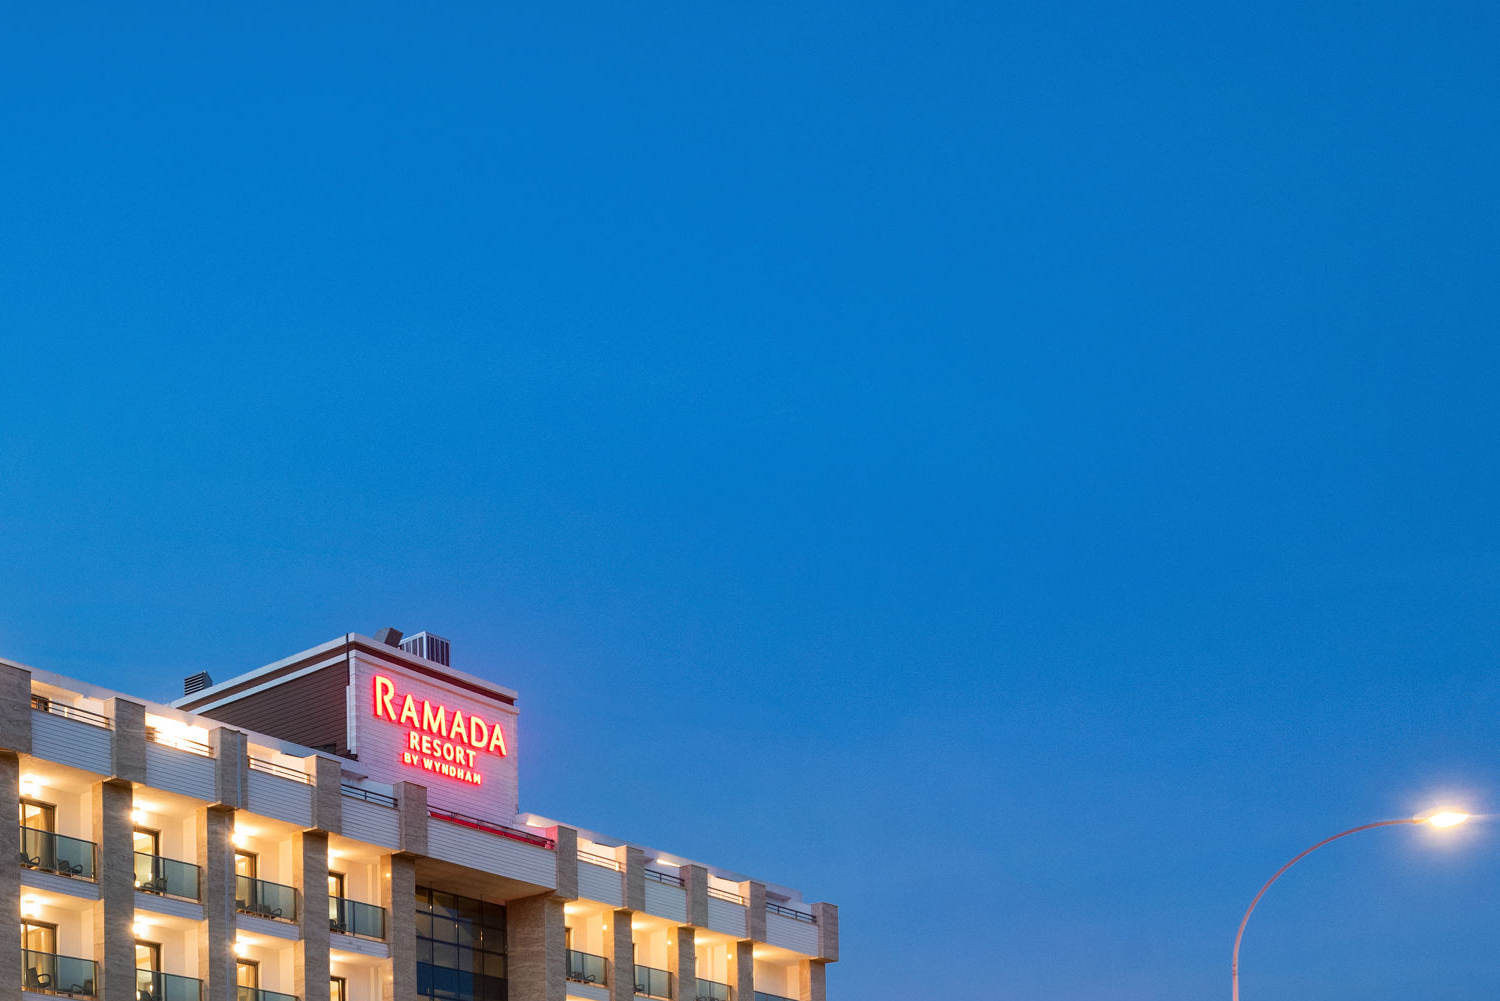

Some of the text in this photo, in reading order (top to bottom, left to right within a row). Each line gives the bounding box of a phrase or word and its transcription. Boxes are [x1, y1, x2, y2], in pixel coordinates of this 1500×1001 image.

[374, 675, 507, 757] RAMADA
[409, 731, 476, 767] RESORT
[403, 752, 481, 785] BY WYNDHAM
